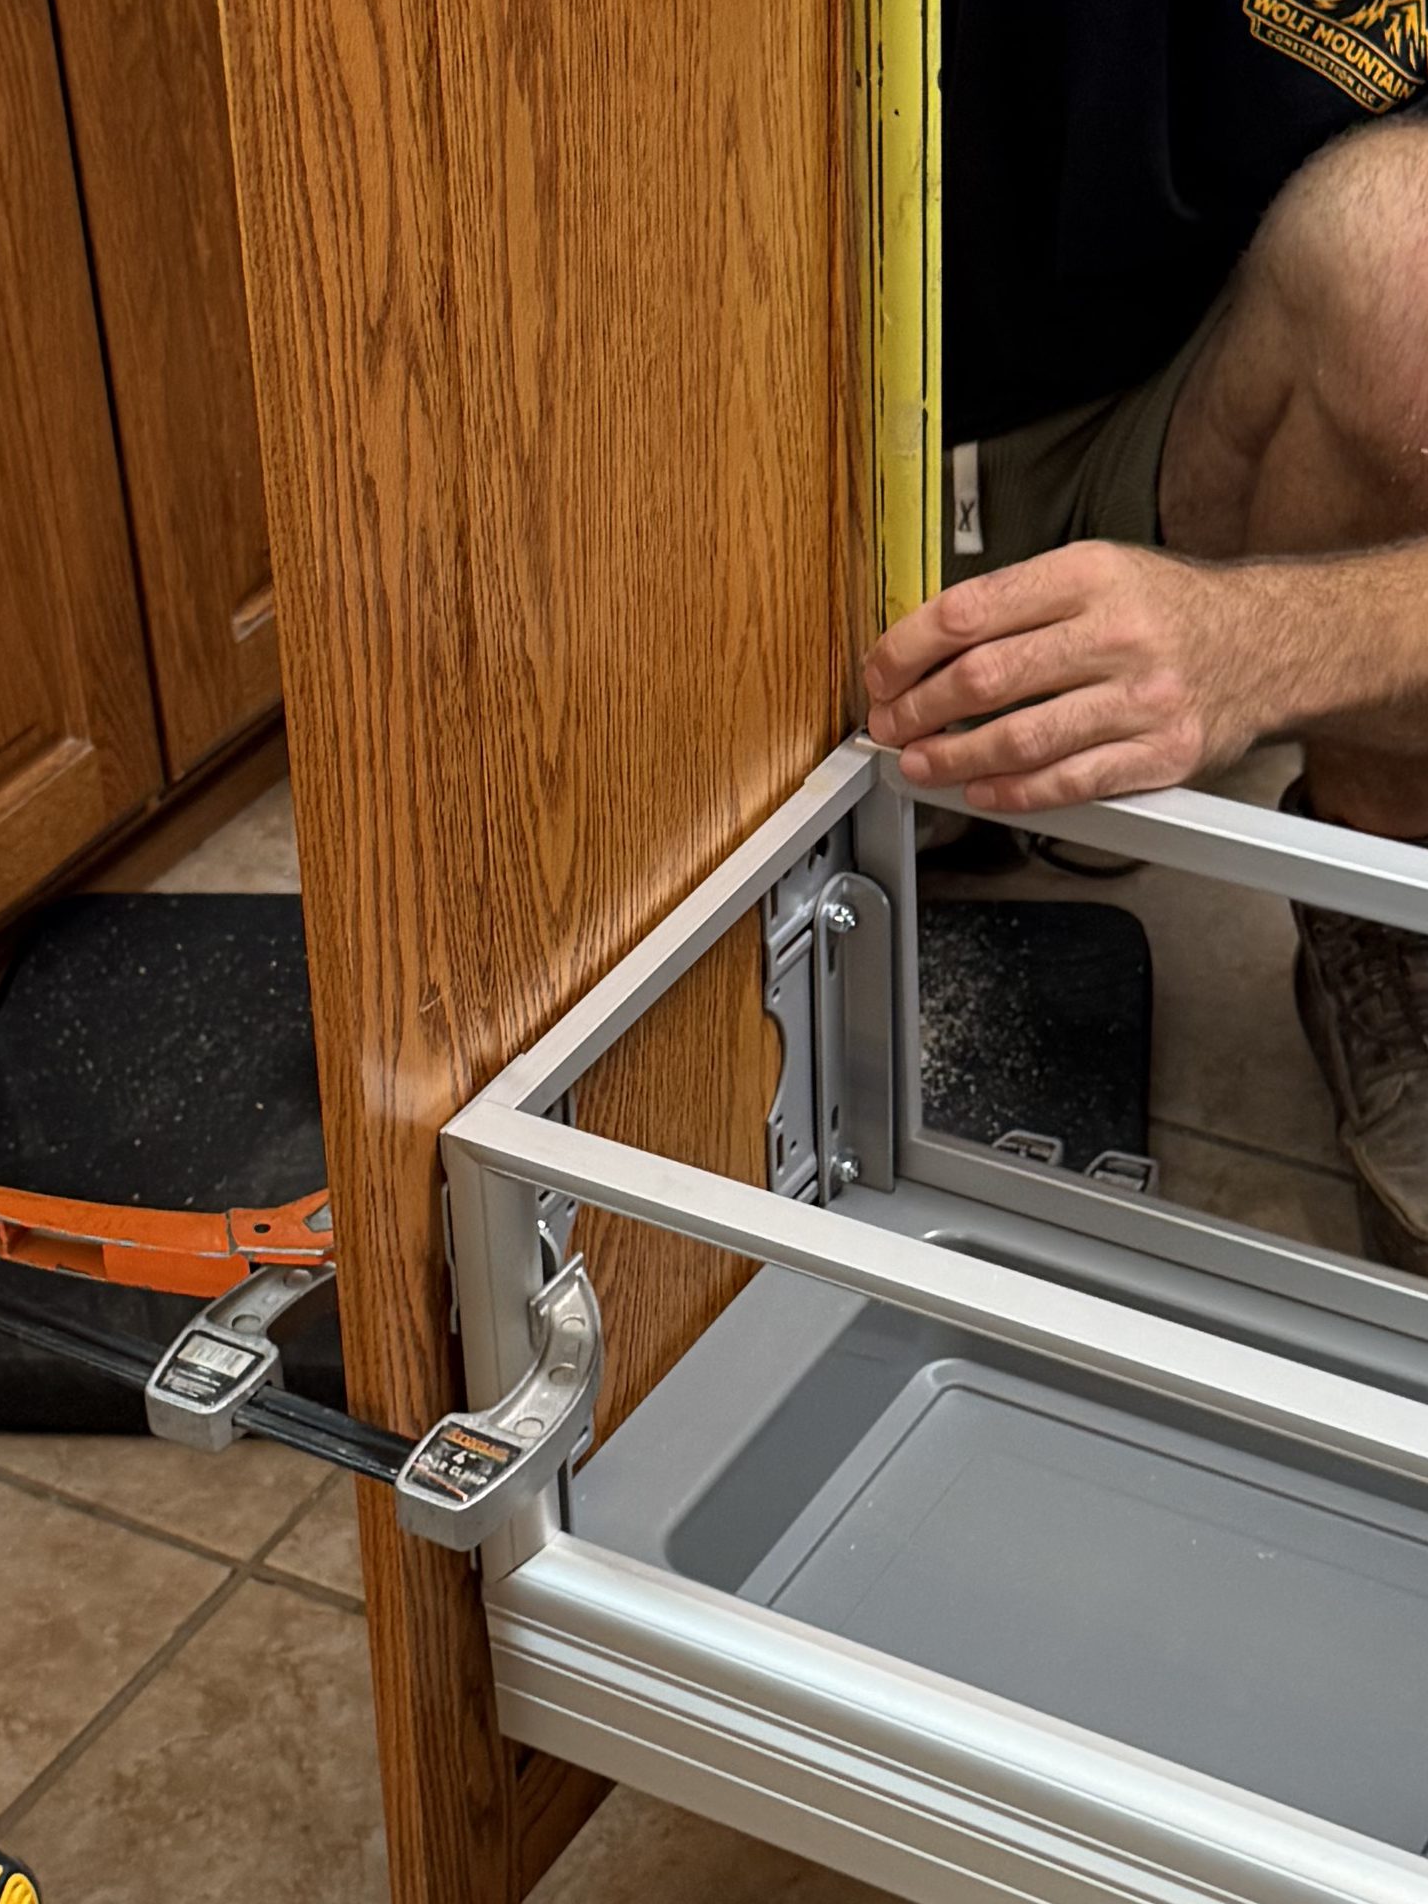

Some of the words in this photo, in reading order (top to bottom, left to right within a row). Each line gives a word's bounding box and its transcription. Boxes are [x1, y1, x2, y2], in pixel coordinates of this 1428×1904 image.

[1266, 29, 1355, 87] CONSTRUCTION
[1355, 85, 1377, 106] LLC
[1312, 23, 1417, 100] MOUNTAIN
